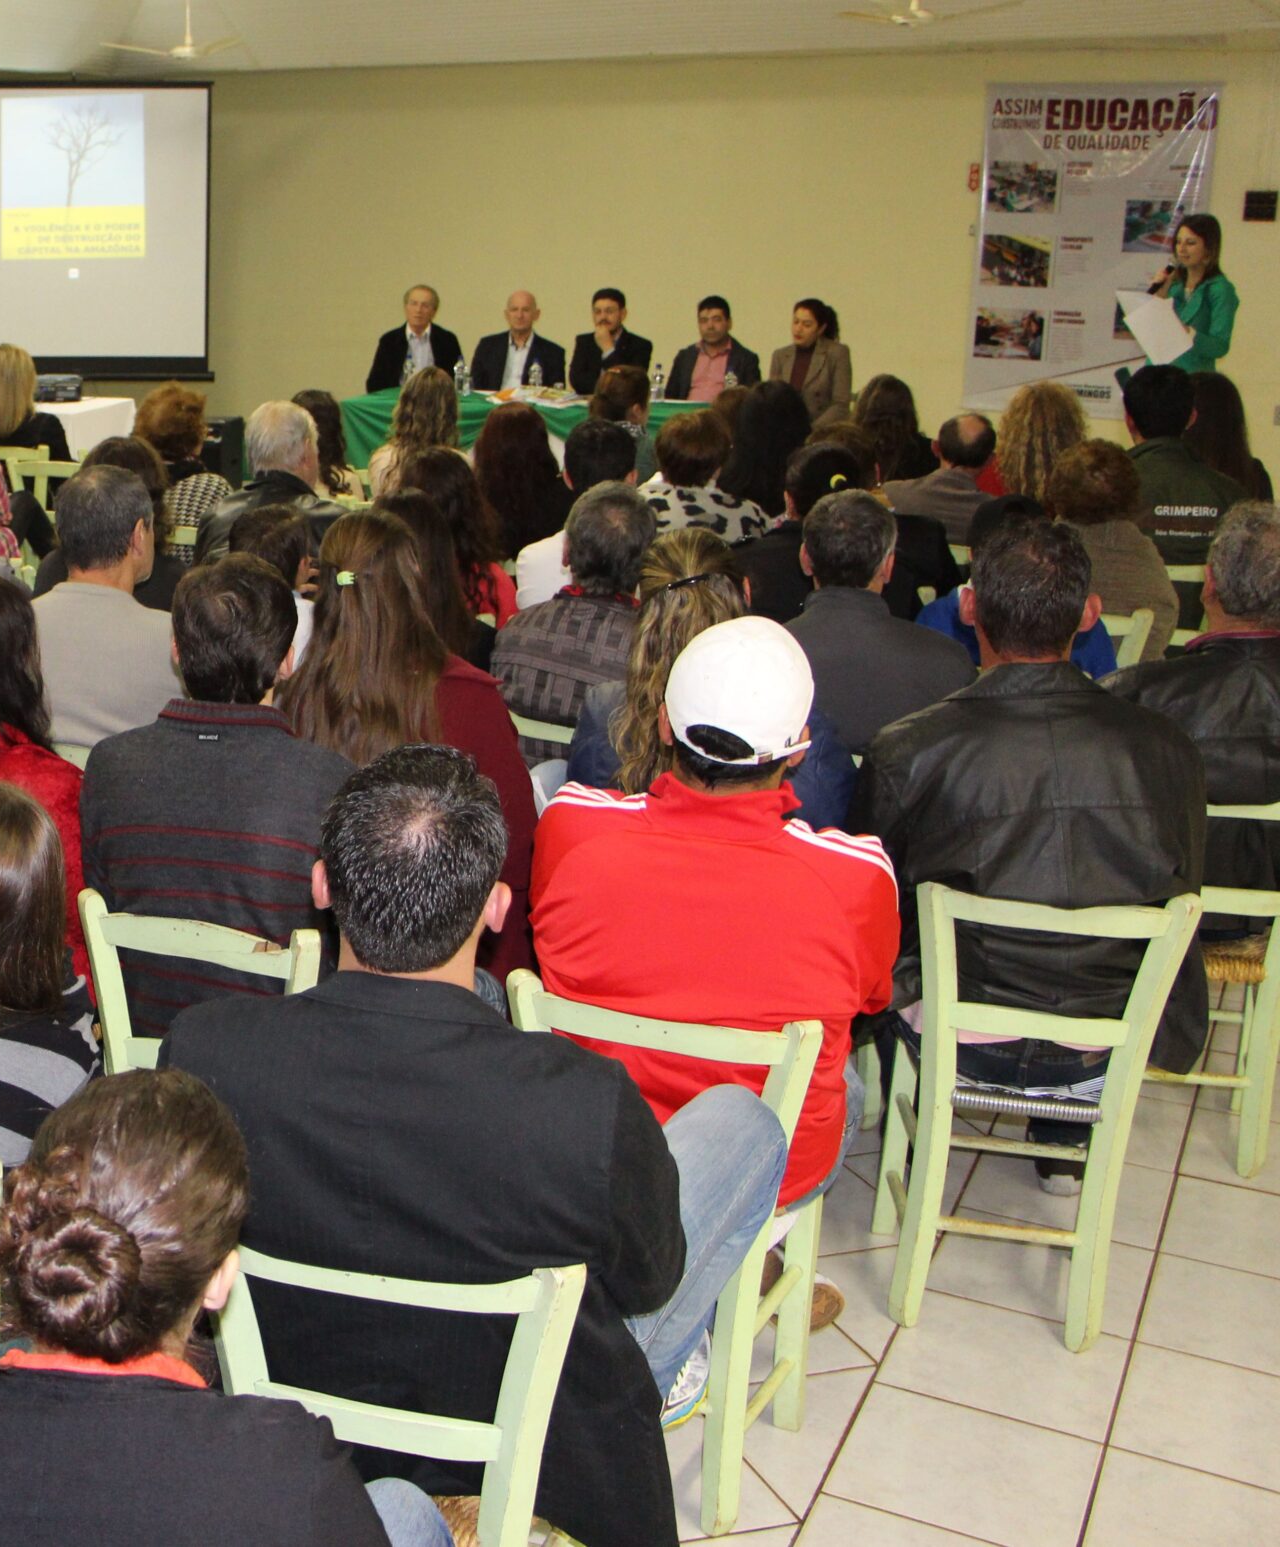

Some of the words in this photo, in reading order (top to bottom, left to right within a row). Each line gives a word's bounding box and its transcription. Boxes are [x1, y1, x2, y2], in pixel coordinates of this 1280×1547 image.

[993, 98, 1043, 116] ASSIM
[1045, 92, 1219, 137] EDUCAÇÃO
[1043, 134, 1062, 150] DE
[1067, 134, 1150, 150] QUALIDADE
[1154, 505, 1218, 517] GRIMPEIRO
